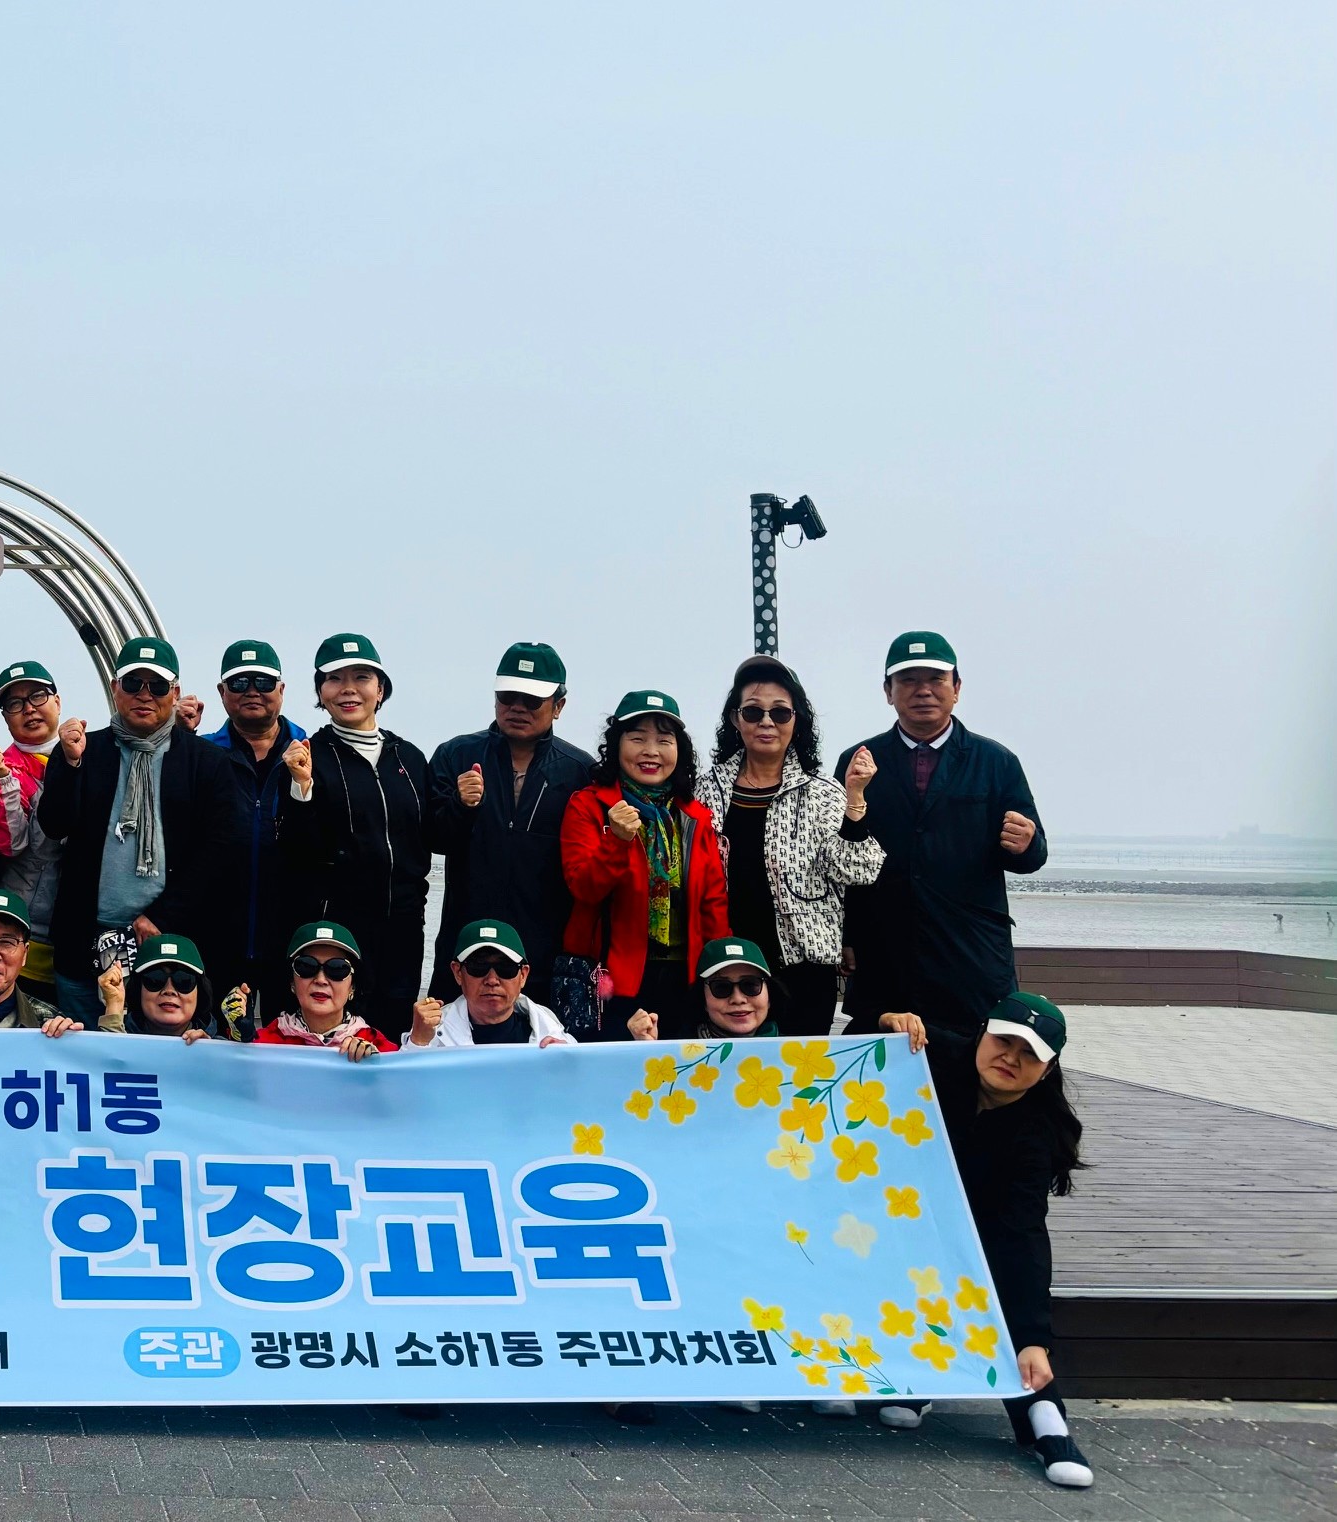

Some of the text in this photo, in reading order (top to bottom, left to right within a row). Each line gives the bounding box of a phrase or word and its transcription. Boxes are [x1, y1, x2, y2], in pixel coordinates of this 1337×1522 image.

[39, 1149, 678, 1308] 현장교육
[139, 1329, 778, 1371] 주관 광명시 소하1동 주민자치회
